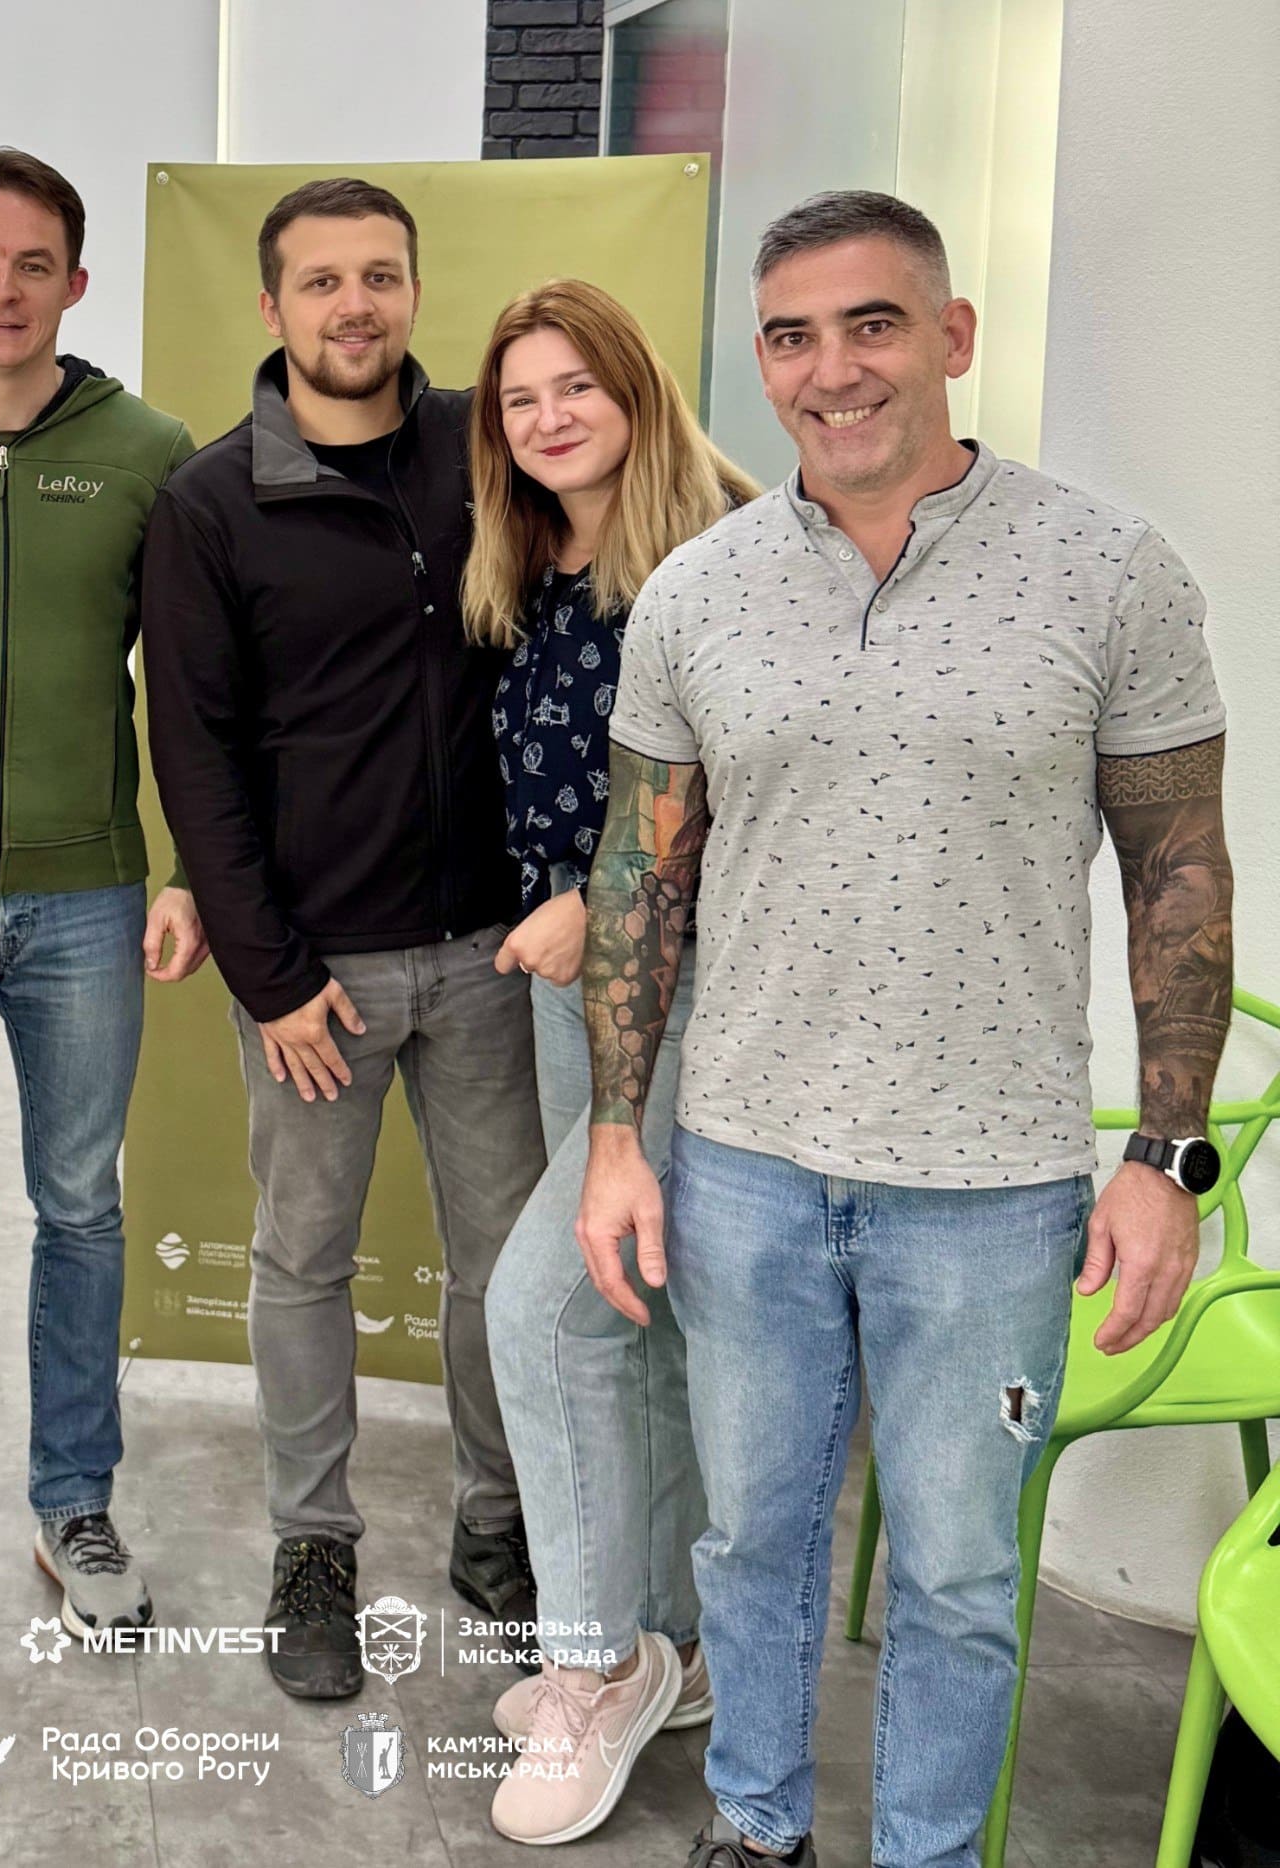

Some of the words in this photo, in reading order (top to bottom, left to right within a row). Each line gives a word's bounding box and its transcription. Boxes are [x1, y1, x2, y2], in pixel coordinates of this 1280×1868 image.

[37, 474, 104, 498] LeRoy
[40, 493, 86, 504] FISHING
[403, 1313, 437, 1328] Рада
[407, 1325, 440, 1340] Крив
